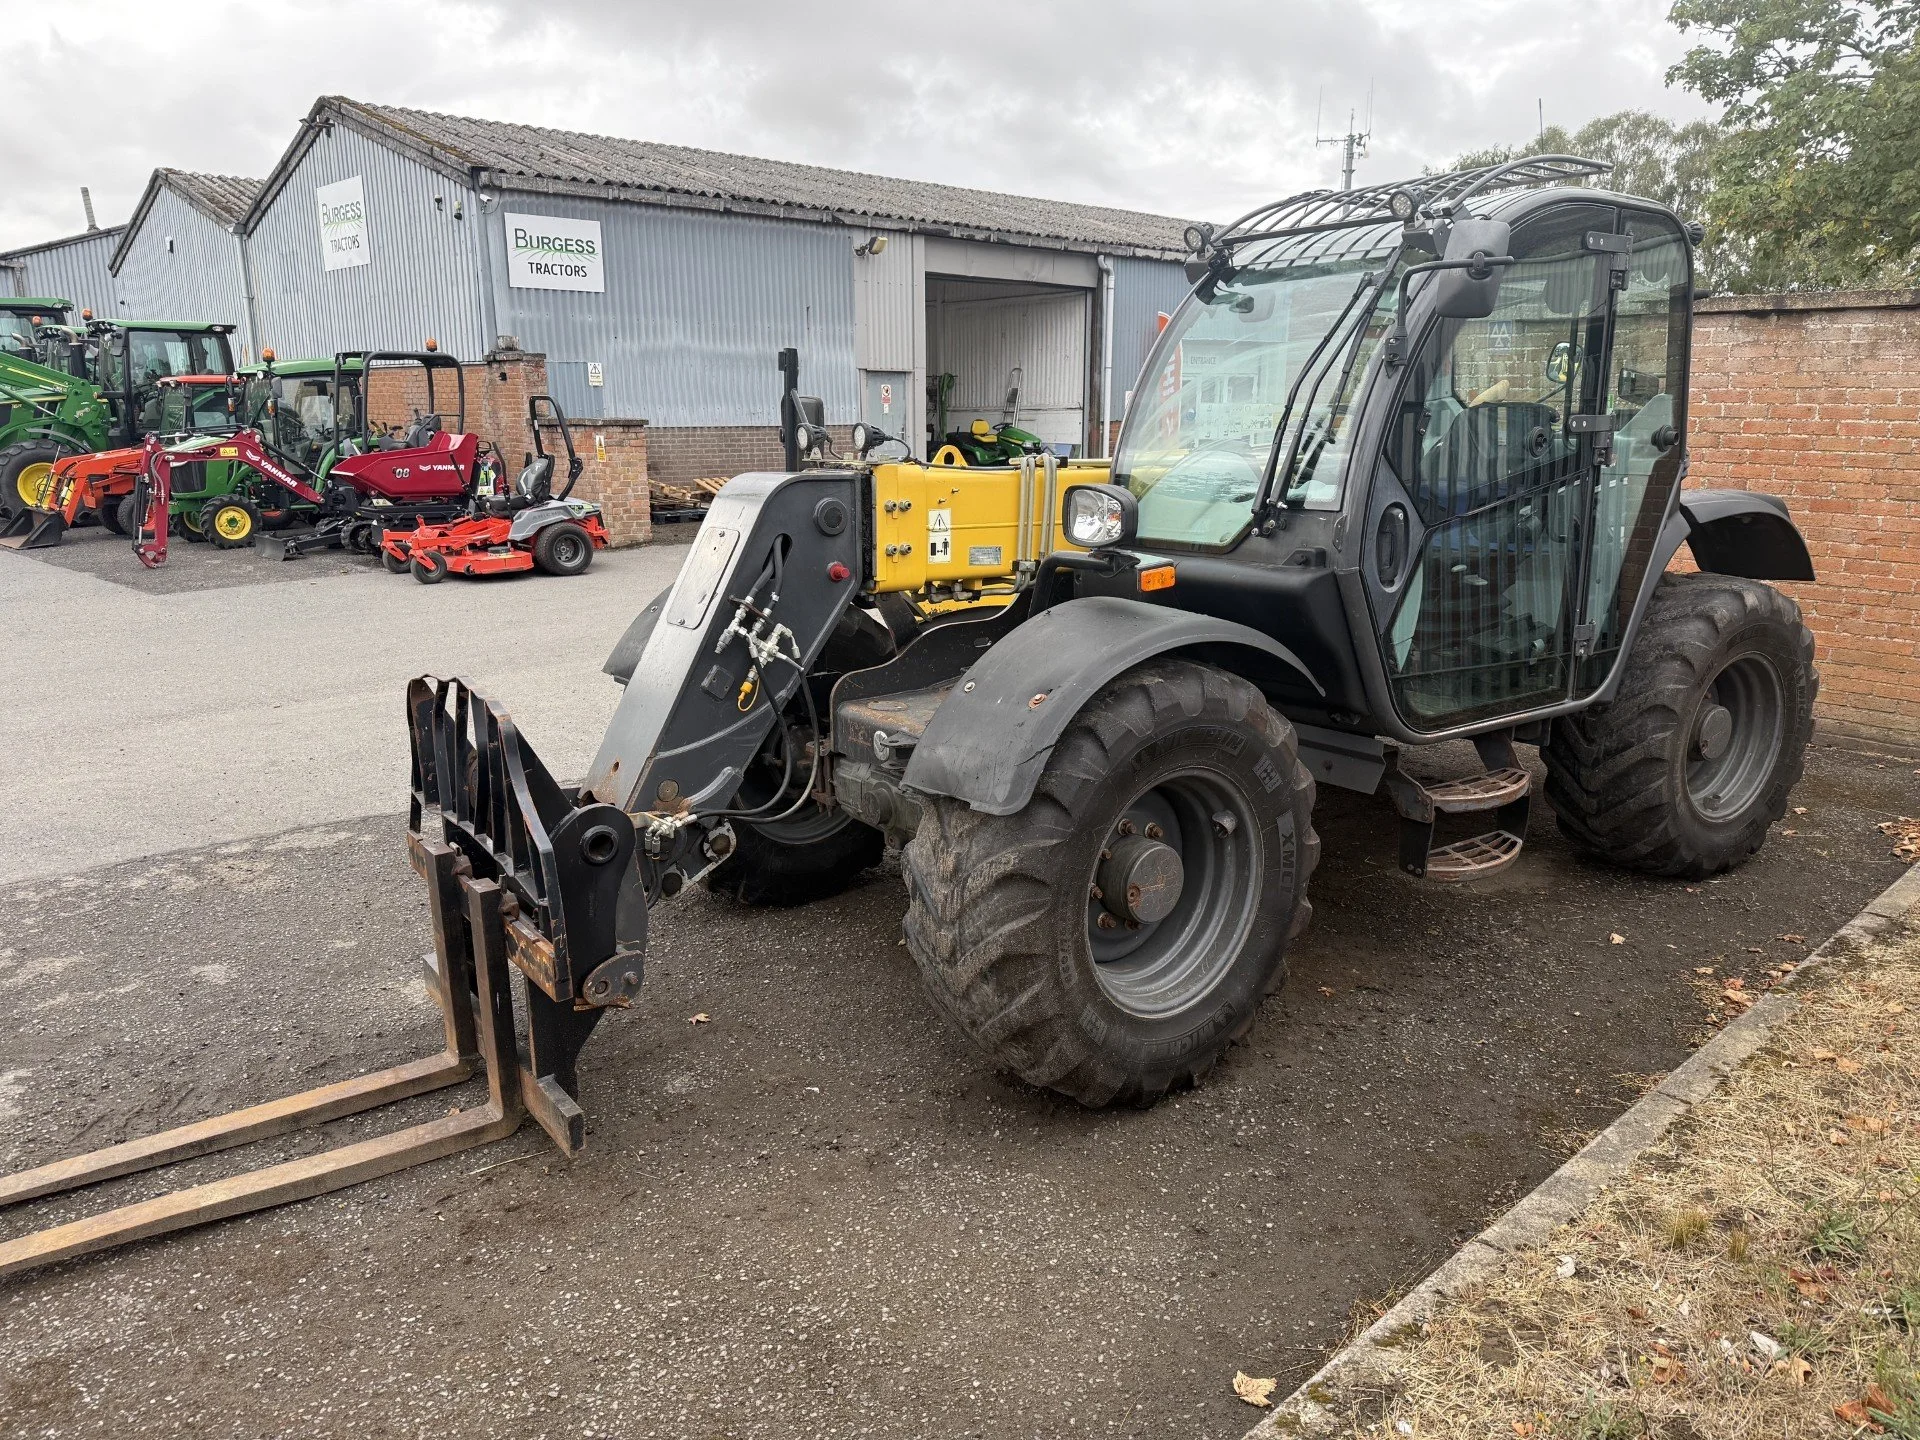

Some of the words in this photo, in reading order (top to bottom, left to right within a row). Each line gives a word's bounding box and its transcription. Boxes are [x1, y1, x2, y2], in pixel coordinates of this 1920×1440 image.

[322, 201, 362, 226] BURGESS
[330, 235, 360, 253] TRACTORS
[514, 228, 596, 254] BURGESS
[528, 262, 588, 278] TRACTORS
[261, 460, 298, 487] YANMAR
